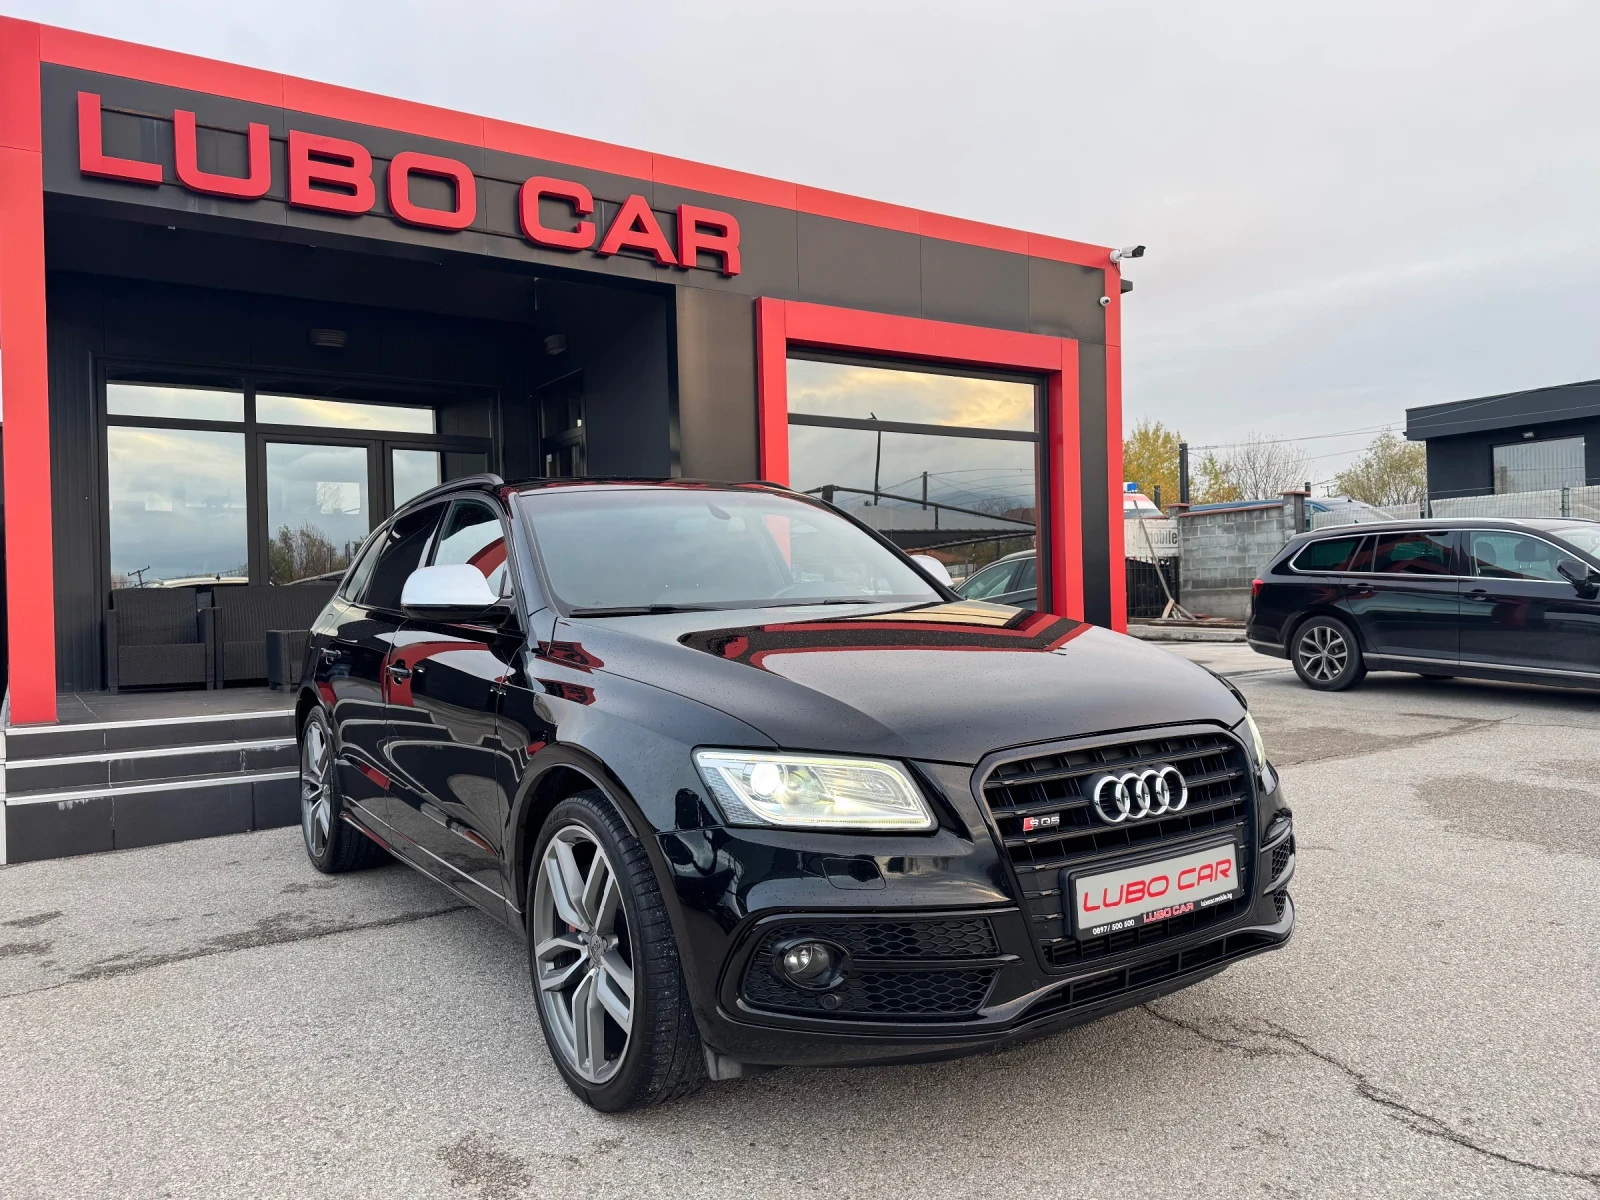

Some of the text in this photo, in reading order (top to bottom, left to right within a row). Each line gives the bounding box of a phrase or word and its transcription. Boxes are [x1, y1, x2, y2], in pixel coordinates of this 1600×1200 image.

[78, 91, 741, 277] LUBO CAR
[1083, 858, 1232, 913] LUBO CAR
[1111, 921, 1123, 931] 500
[1123, 919, 1135, 928] 500
[1143, 902, 1195, 923] LUBO CAR
